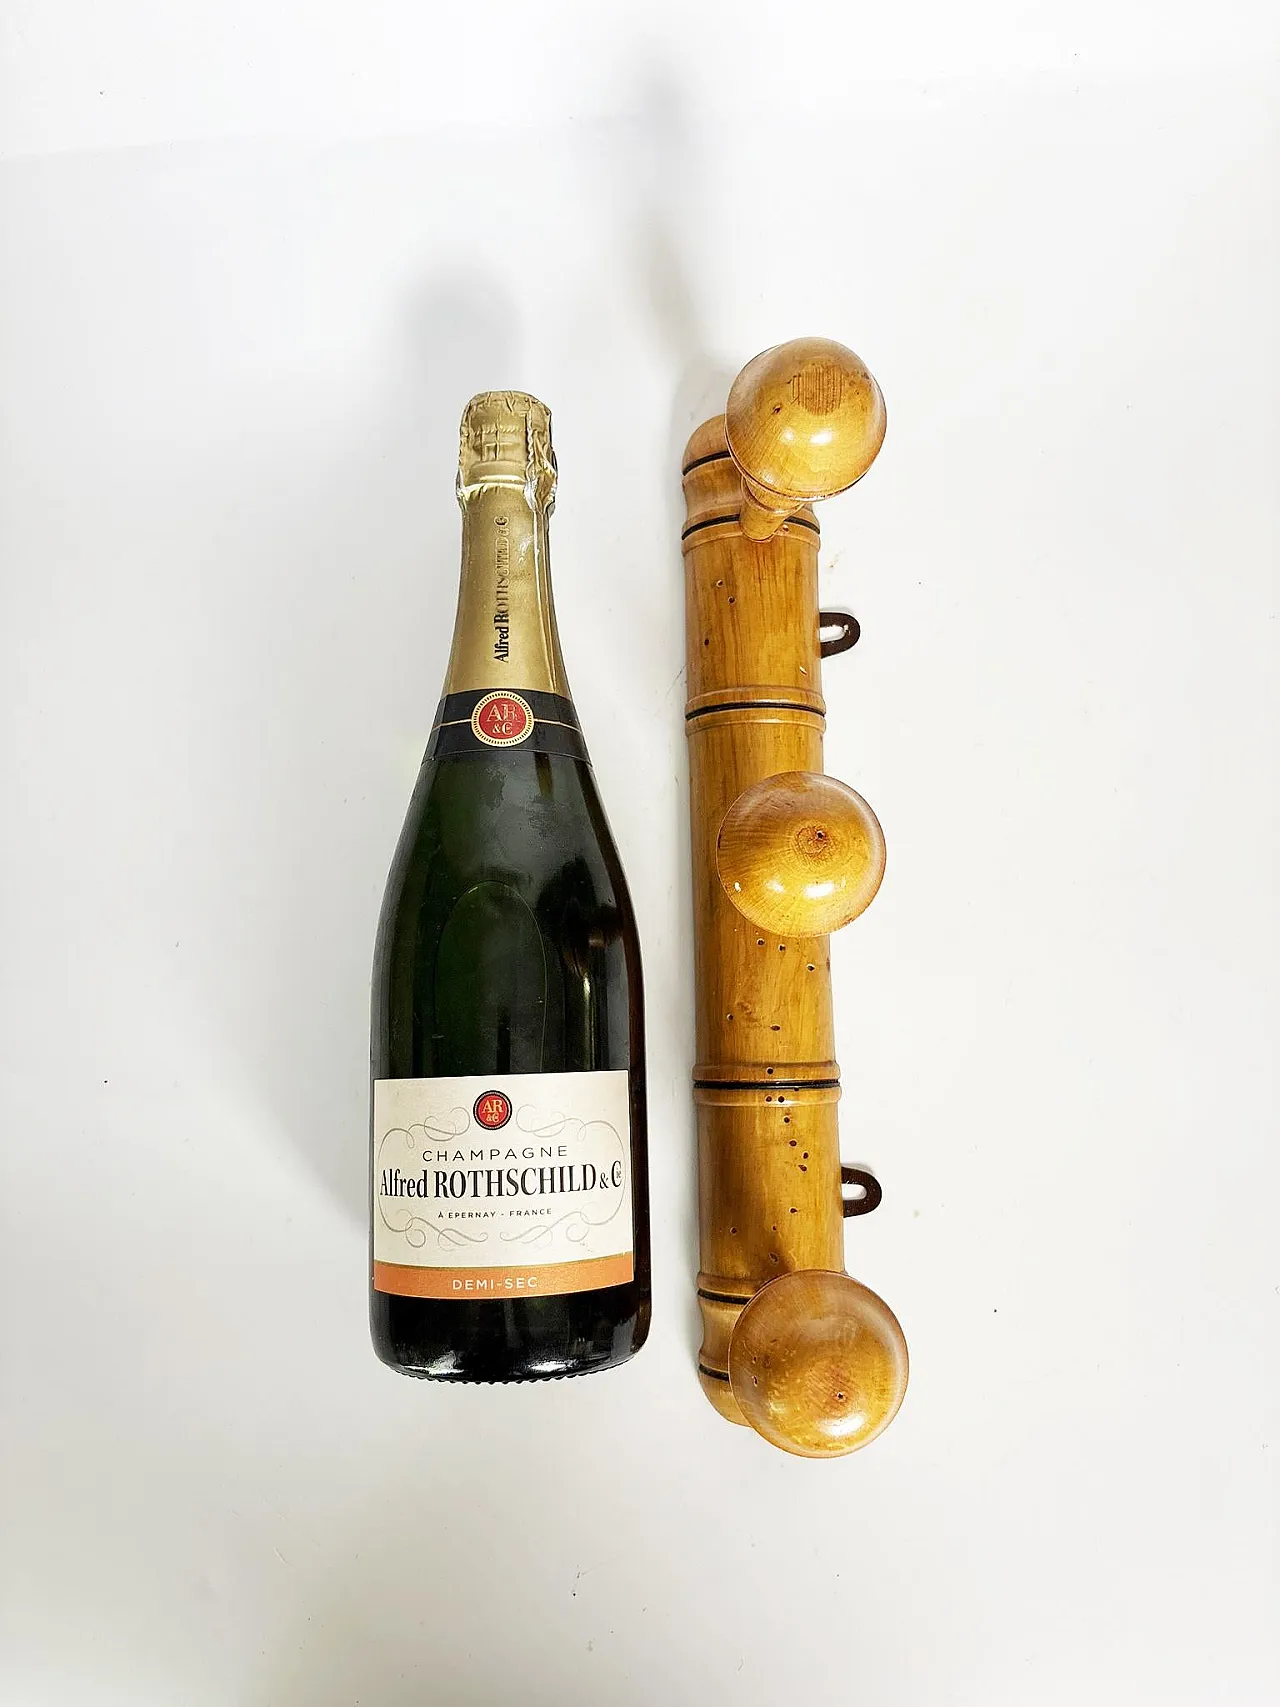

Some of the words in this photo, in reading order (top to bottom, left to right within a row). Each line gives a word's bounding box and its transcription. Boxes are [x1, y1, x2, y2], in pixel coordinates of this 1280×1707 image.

[494, 626, 509, 663] Alfred
[481, 1099, 504, 1114] AR
[422, 1145, 568, 1162] CHAMPAGNE
[380, 1168, 429, 1198] Alfred
[433, 1163, 596, 1199] ROTHSCHILD
[448, 1211, 496, 1219] EPERNAY
[509, 1208, 552, 1217] FRANCE
[452, 1276, 538, 1290] DEMI-SEC
